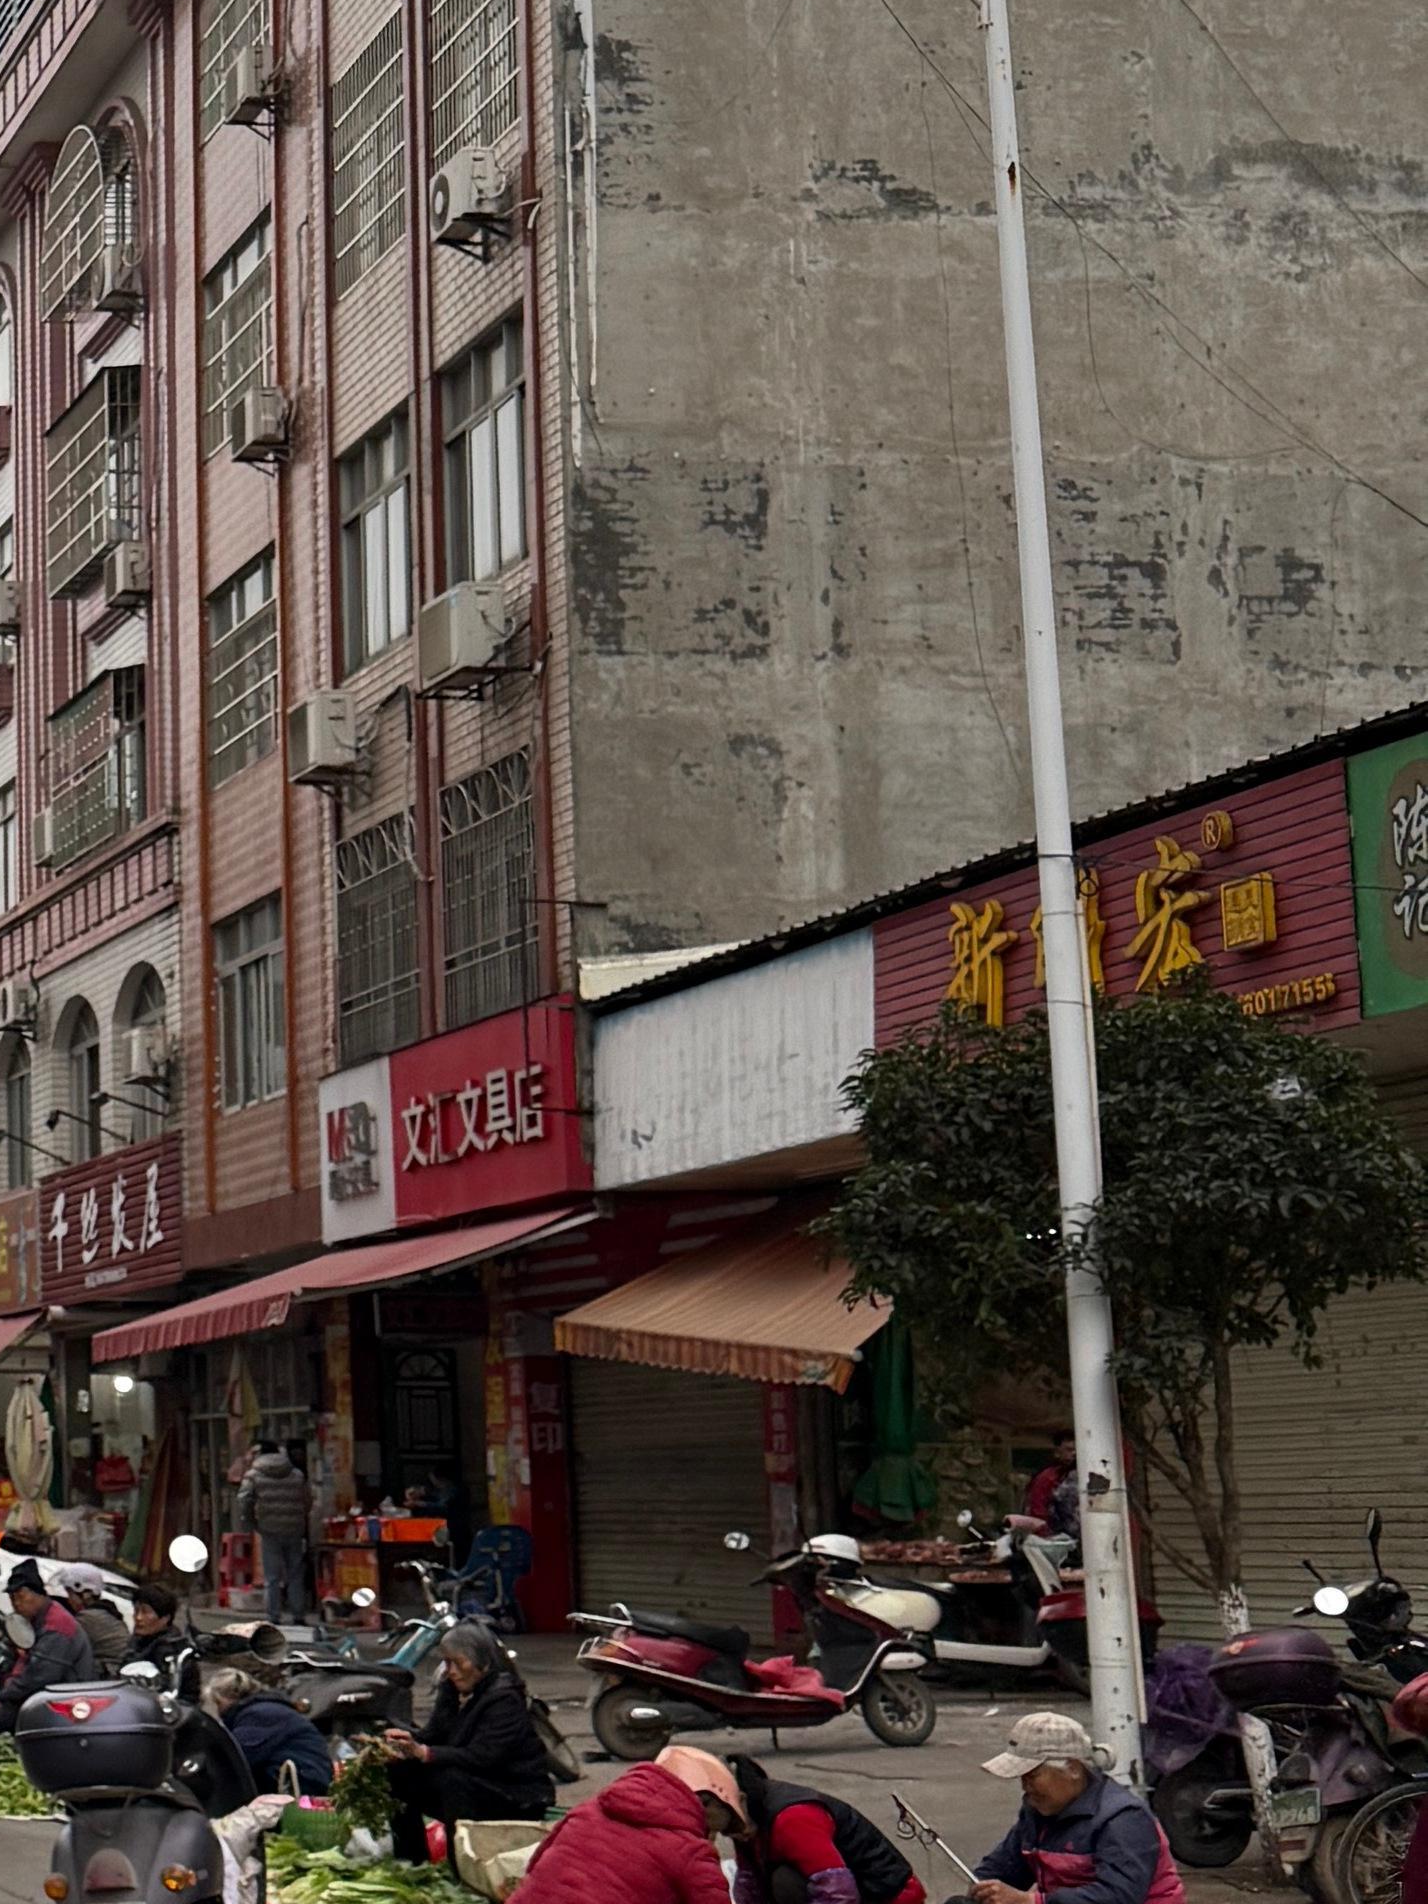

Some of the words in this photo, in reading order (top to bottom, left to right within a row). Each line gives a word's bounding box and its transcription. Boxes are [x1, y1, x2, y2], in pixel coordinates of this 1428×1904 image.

[947, 835, 1214, 1028] 新宏
[401, 1064, 543, 1172] 文汇文具店
[530, 1381, 562, 1453] 复印
